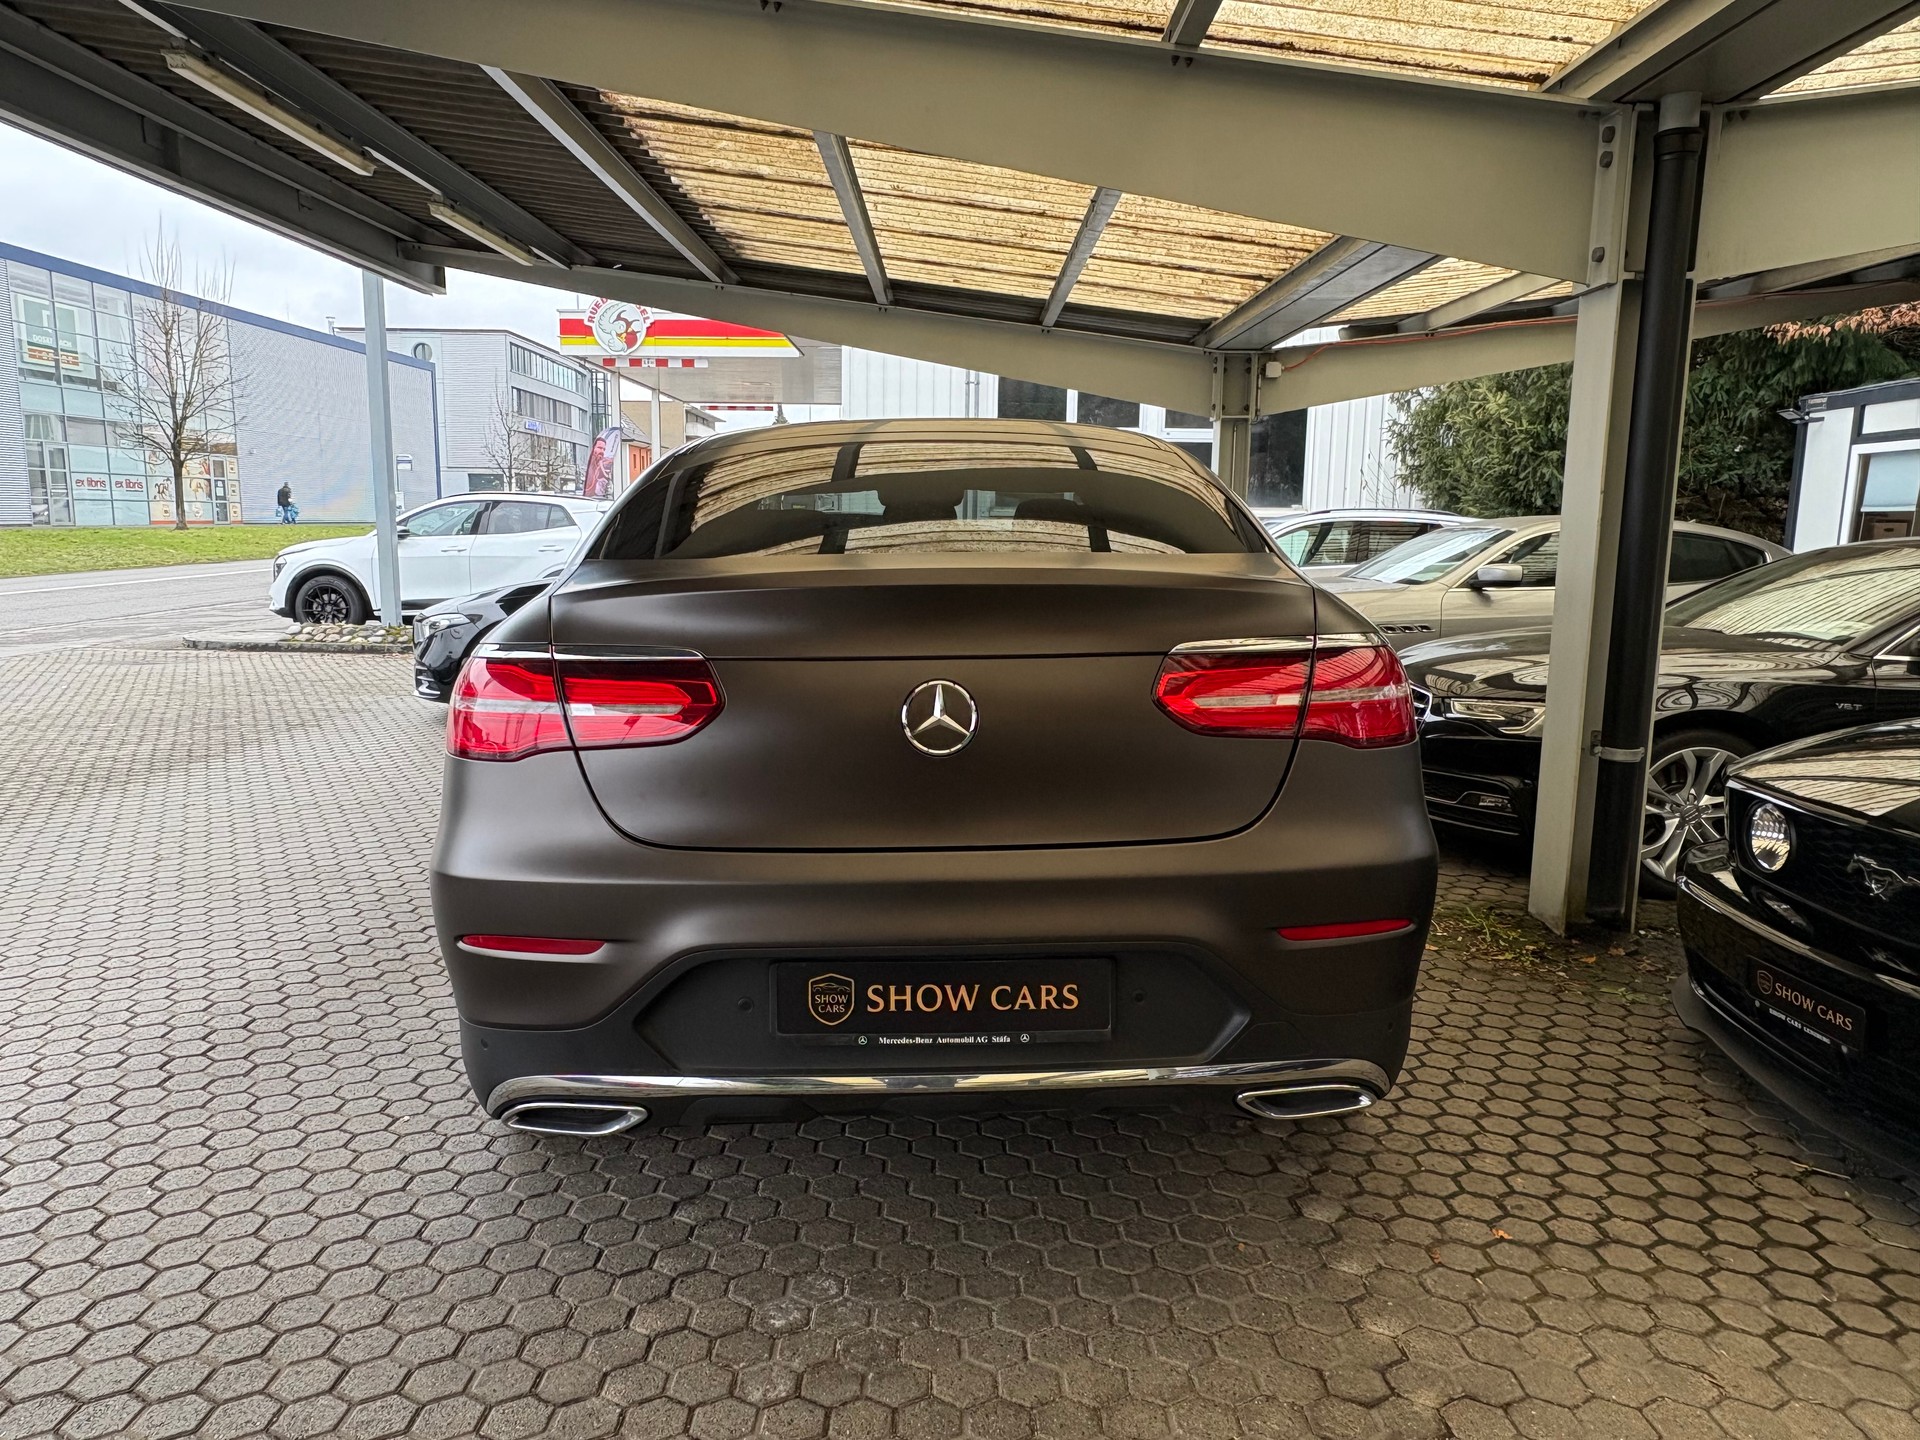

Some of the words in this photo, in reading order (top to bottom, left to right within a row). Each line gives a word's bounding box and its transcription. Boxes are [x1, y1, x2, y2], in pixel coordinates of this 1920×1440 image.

[588, 298, 608, 324] RUED
[75, 478, 85, 488] ex
[86, 477, 107, 489] libris
[114, 480, 124, 489] ex
[125, 478, 144, 490] libris
[814, 993, 849, 1004] SHOW
[866, 983, 980, 1013] SHOW
[990, 984, 1079, 1011] CARS
[818, 1004, 846, 1013] CARS
[1774, 982, 1815, 1013] SHOW
[1816, 1004, 1853, 1031] CARS
[878, 1036, 933, 1045] Mercedes-Benz
[936, 1036, 974, 1044] Automobil
[975, 1035, 988, 1044] AG
